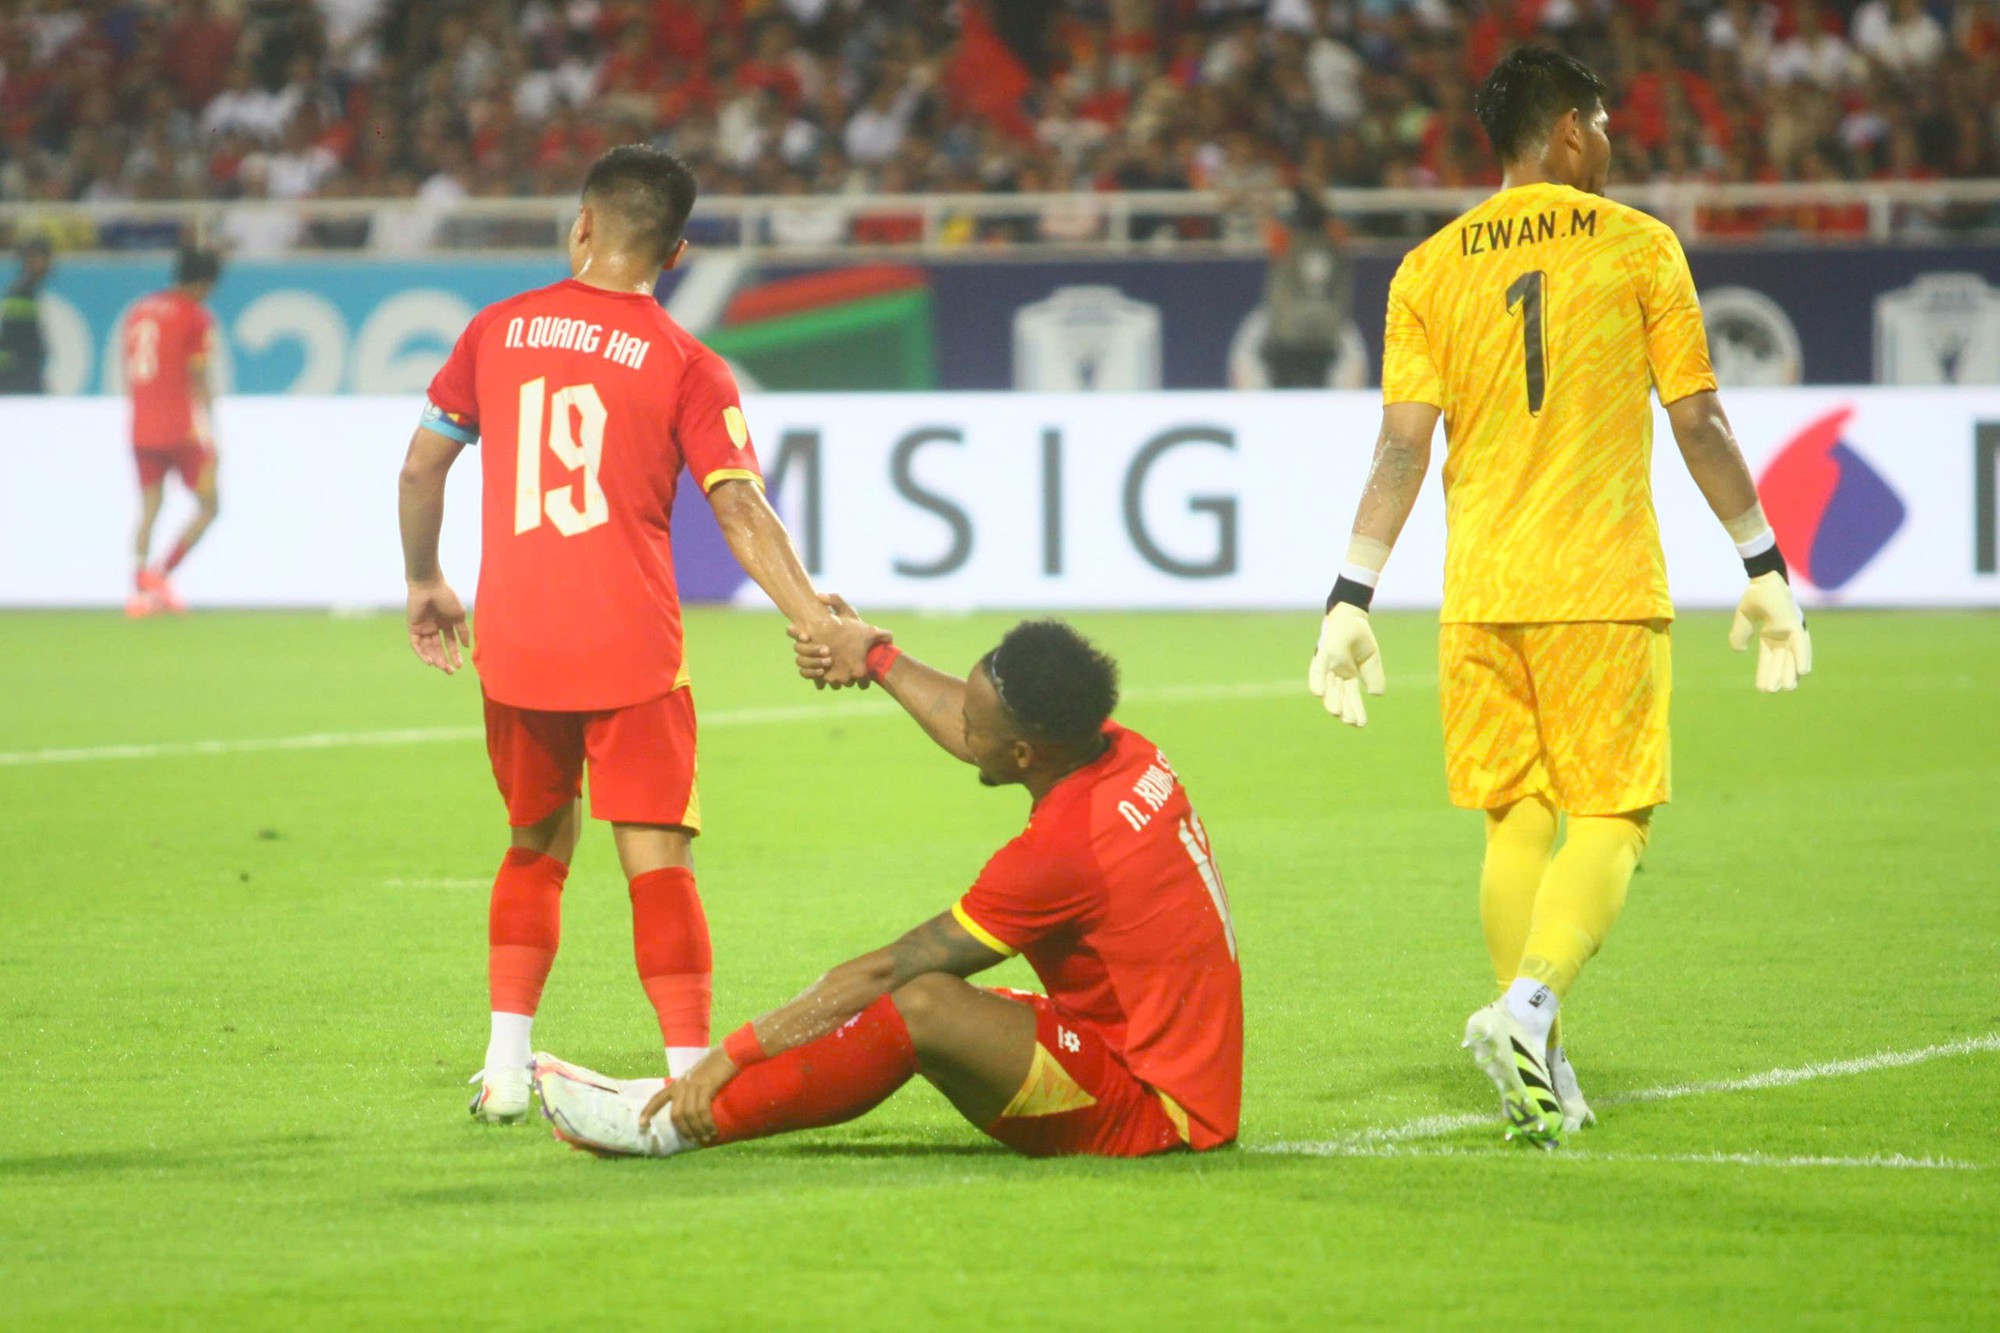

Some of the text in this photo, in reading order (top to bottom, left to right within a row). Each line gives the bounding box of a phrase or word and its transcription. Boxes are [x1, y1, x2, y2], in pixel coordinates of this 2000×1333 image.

[1461, 208, 1597, 256] IZWAN.M
[602, 329, 651, 370] HAI
[1505, 269, 1549, 418] 1
[514, 376, 609, 538] 19
[1117, 800, 1151, 831] N.
